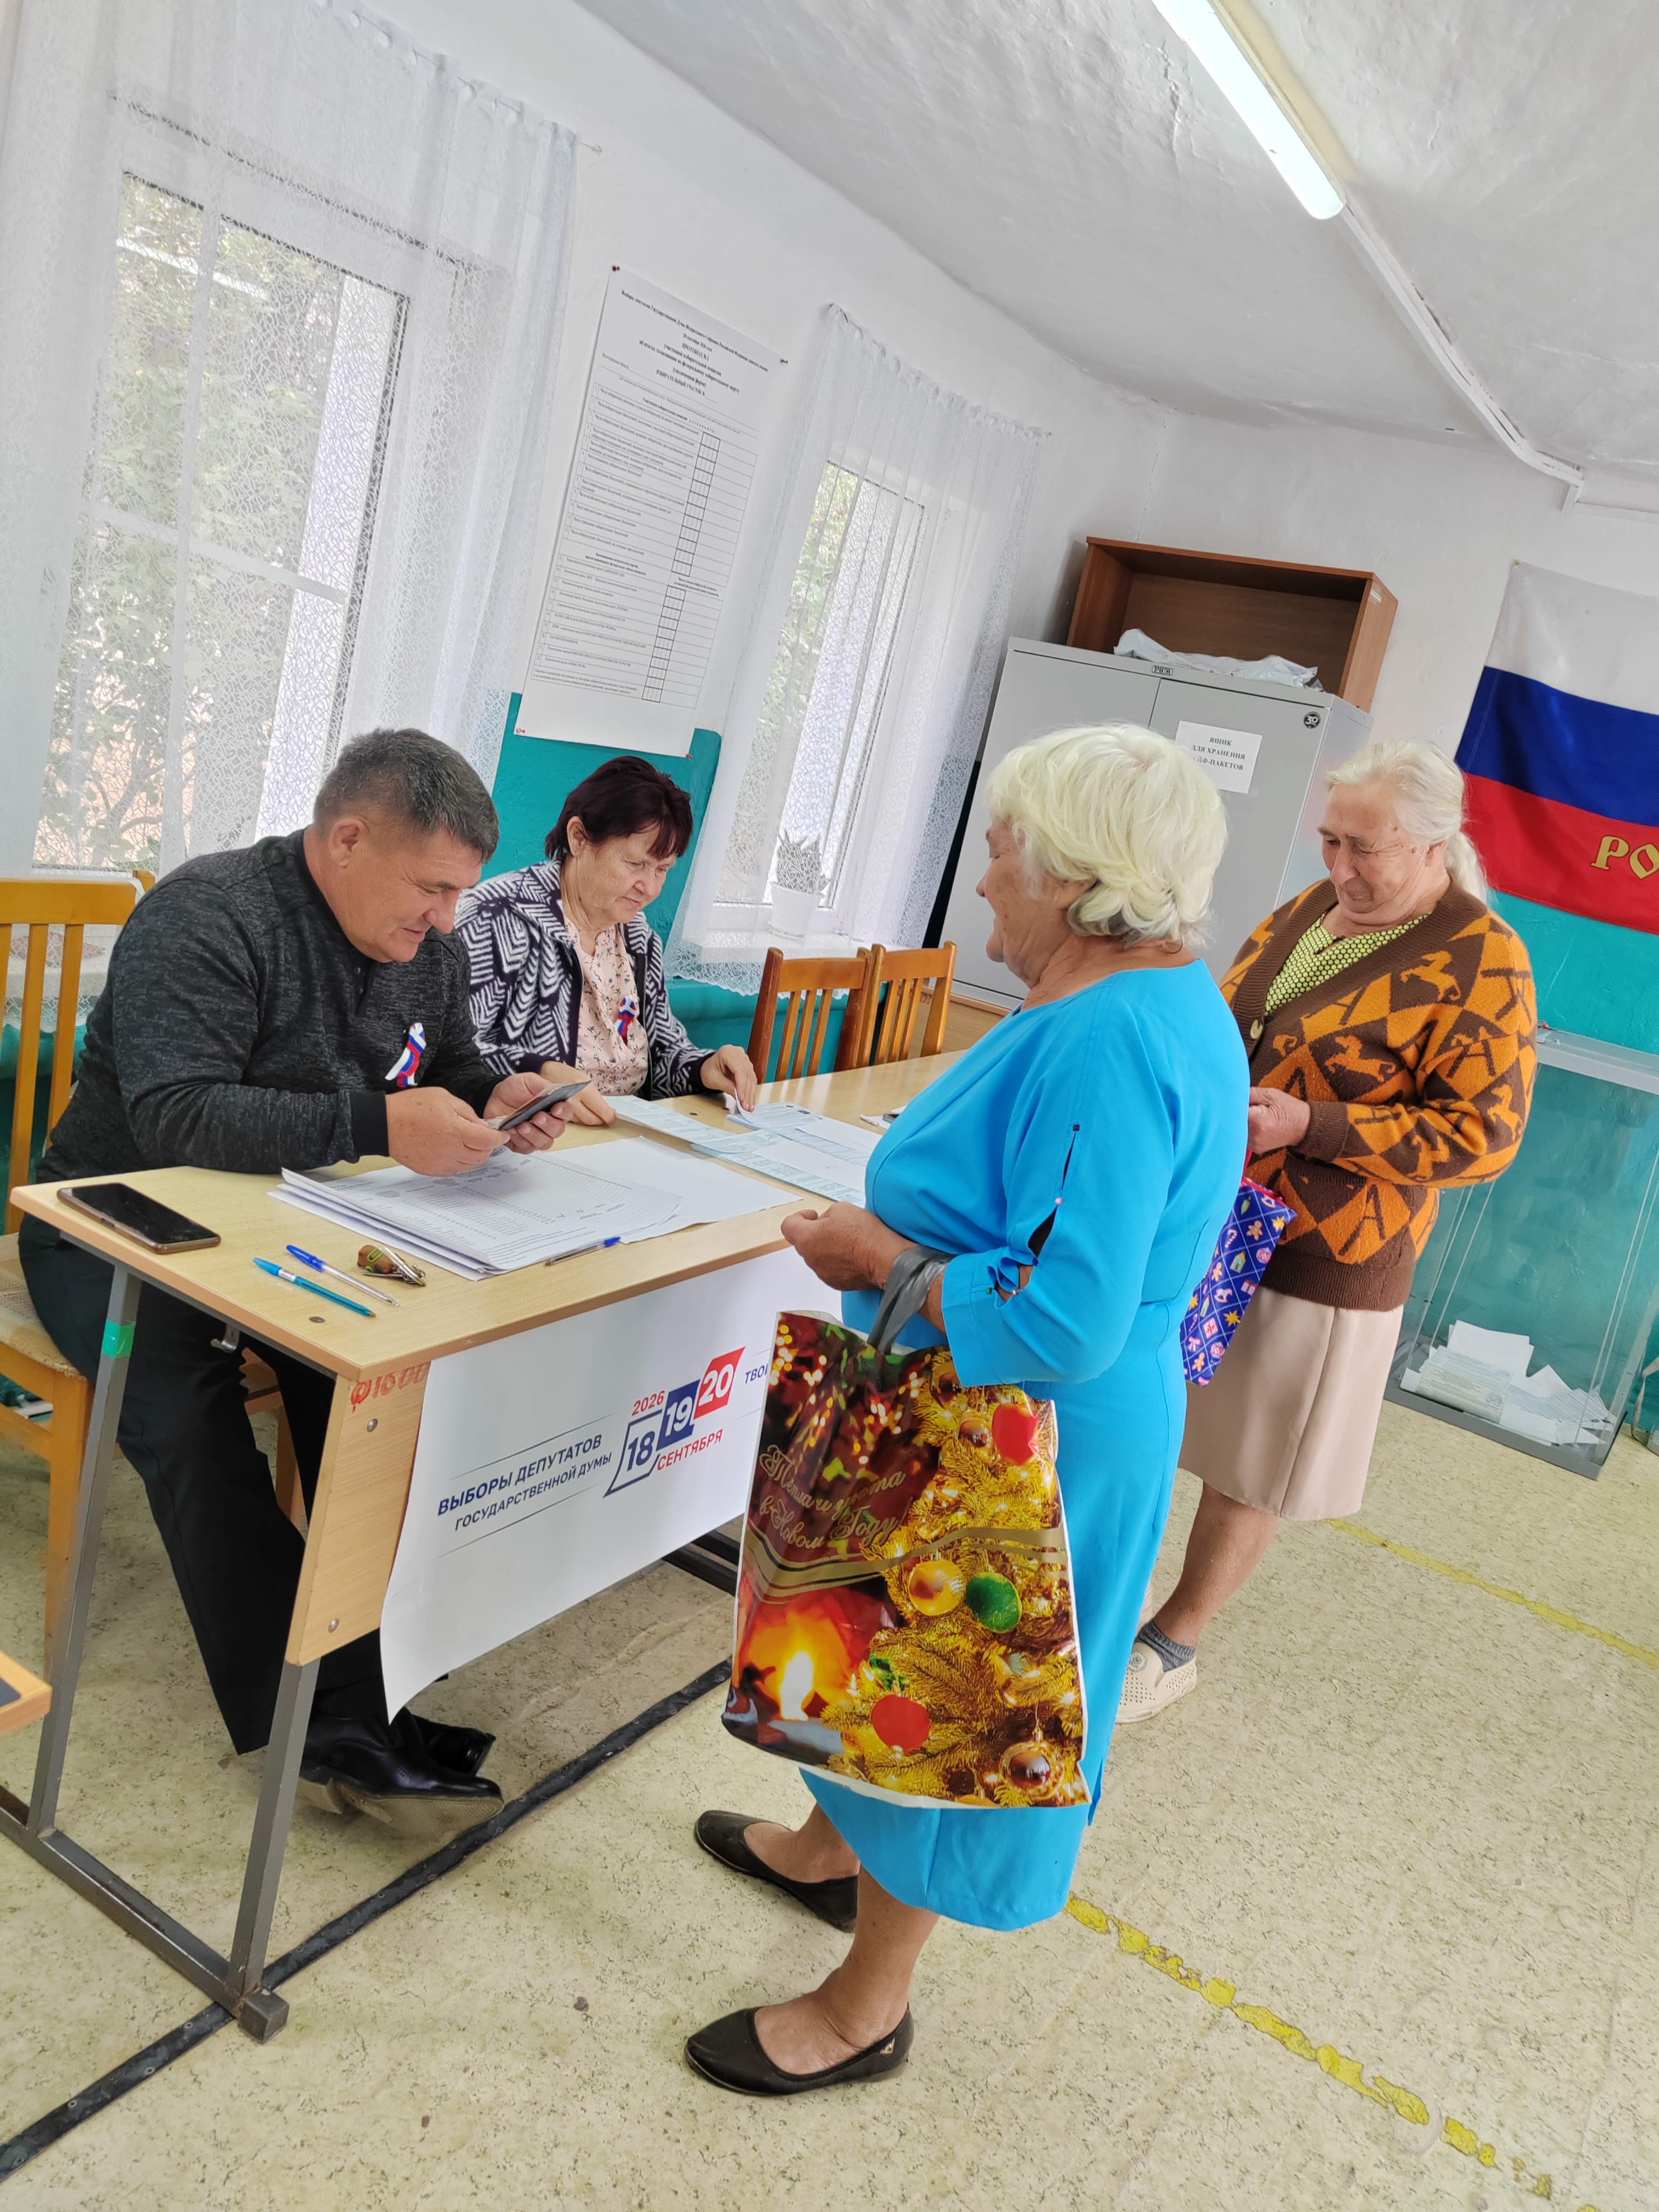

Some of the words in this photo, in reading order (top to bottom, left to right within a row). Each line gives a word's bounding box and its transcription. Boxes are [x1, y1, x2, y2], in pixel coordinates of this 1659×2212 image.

[1206, 747, 1245, 760] ХРАНЕНИЯ
[1209, 737, 1232, 746] ЯЩИК
[627, 1431, 655, 1472] 18
[665, 1396, 693, 1438] 19
[698, 1364, 733, 1407] 20
[631, 1390, 665, 1417] 2026
[438, 1472, 512, 1515] ВЫБОРЫ
[515, 1434, 602, 1486] ДЕПУТАТОВ
[657, 1429, 723, 1471] СЕНТЯБРЯ
[455, 1464, 577, 1532] ГОСУДАРСТВЕННОЙ
[578, 1452, 612, 1480] ДУМЫ
[759, 1444, 814, 1508] Тепла
[771, 1499, 825, 1549] Новом
